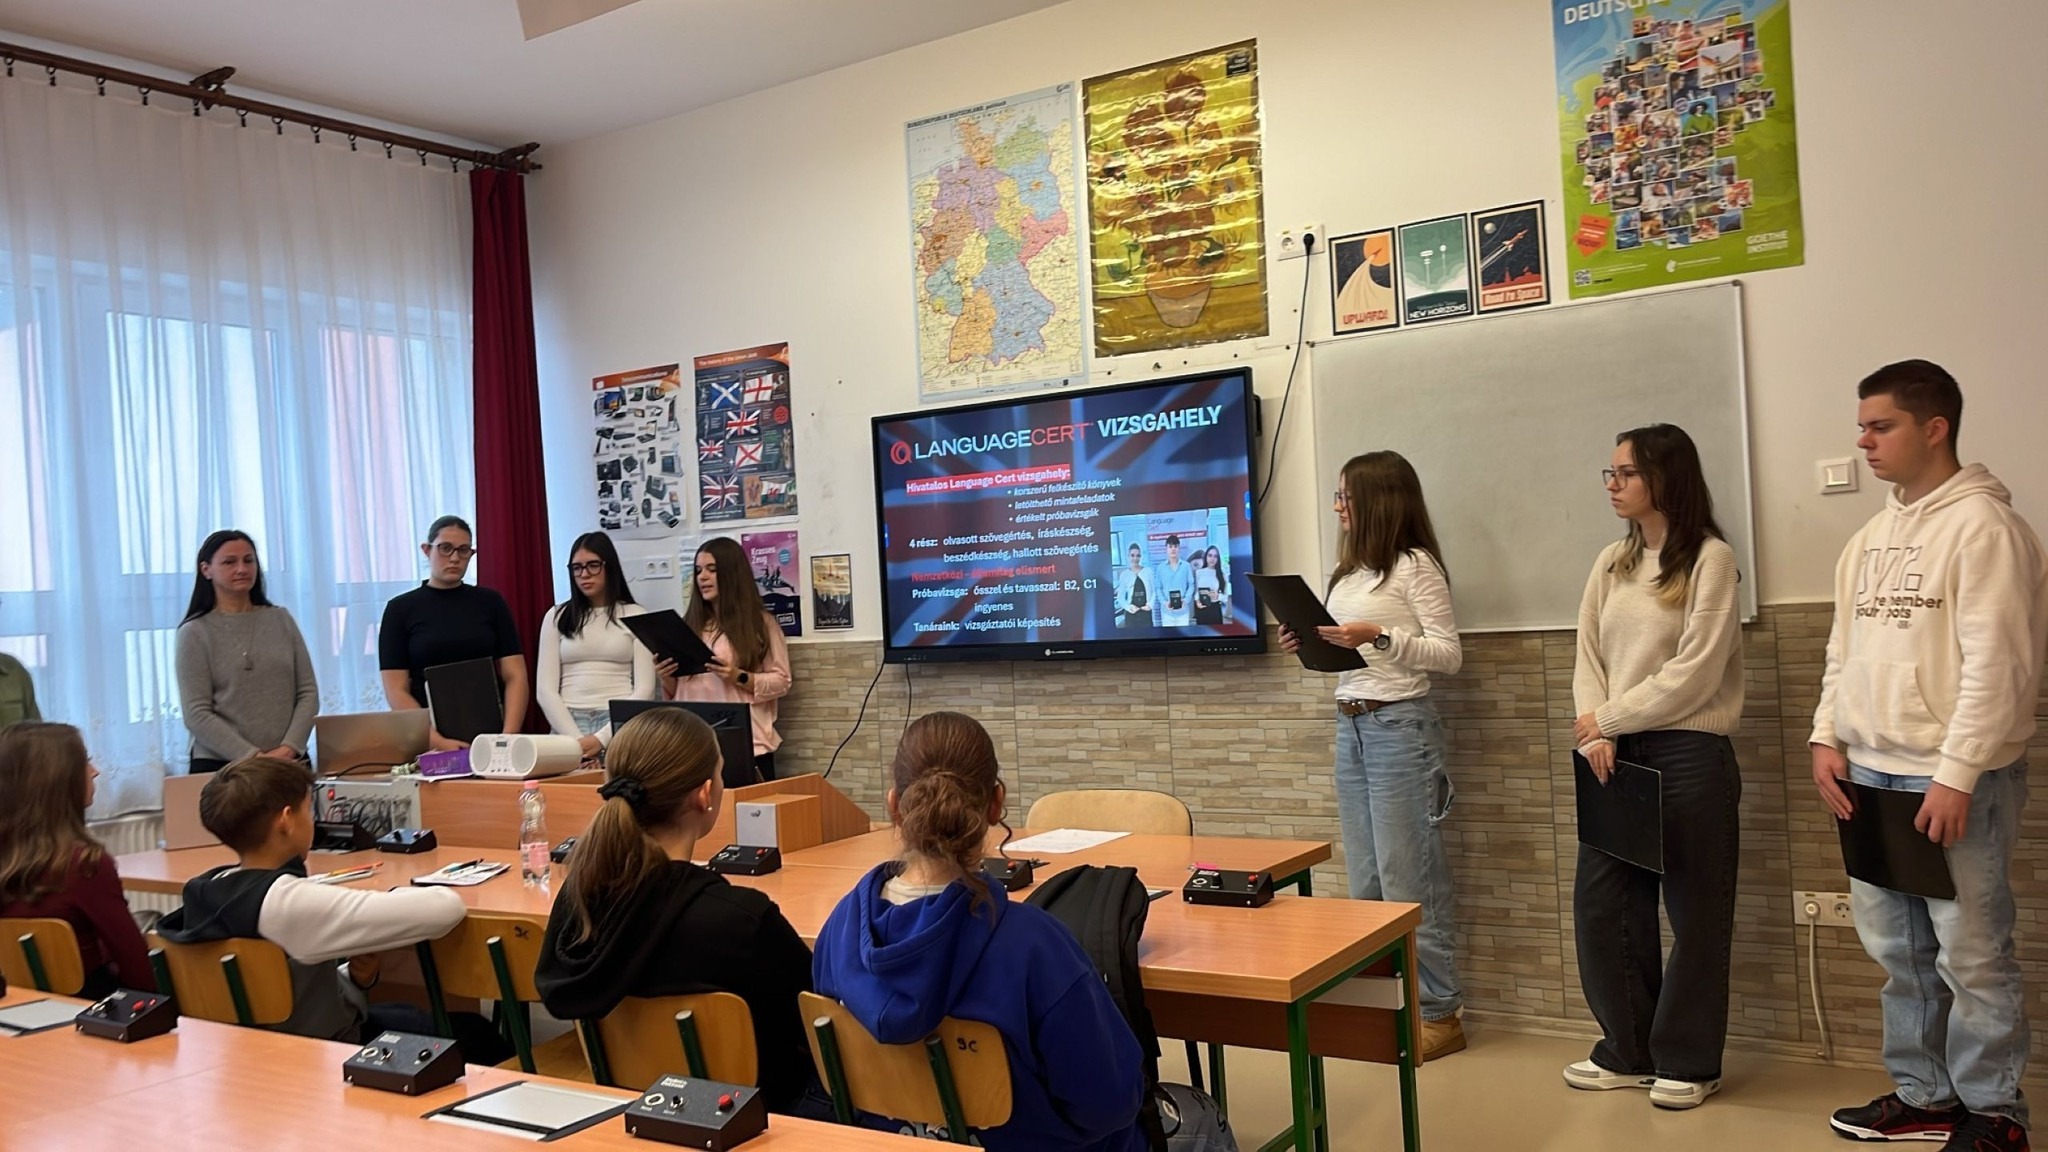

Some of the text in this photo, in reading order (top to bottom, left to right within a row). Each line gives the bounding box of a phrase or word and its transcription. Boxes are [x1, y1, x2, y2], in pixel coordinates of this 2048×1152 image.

[1343, 309, 1389, 325] UPWARD!
[1409, 310, 1427, 319] NEW
[1427, 303, 1467, 315] HORIZONS
[914, 405, 1222, 460] LANGUAGECERT VIZSGAHELY
[906, 468, 1071, 493] Hivatalos Language Cert vizsgahely:
[1054, 492, 1115, 506] mintafeladatok
[1046, 509, 1099, 522] próbavizsgák
[909, 525, 1095, 548] 4 rész: olvasott szövegértés, íráskészség,
[751, 546, 776, 556] Krasses
[943, 542, 1099, 563] beszédkészség, hallott szövegértés
[751, 555, 768, 565] Zeug
[1016, 564, 1056, 576] elismert
[912, 588, 969, 599] Próbavizsga:
[1002, 583, 1014, 594] és
[1015, 580, 1060, 593] tavasszal:
[1064, 579, 1080, 591] B2,
[1083, 578, 1097, 589] C1
[974, 602, 1014, 614] ingyenes
[1875, 595, 1944, 609] reember
[913, 618, 1061, 632] Tanáraink: vizsgáztatói képesítés
